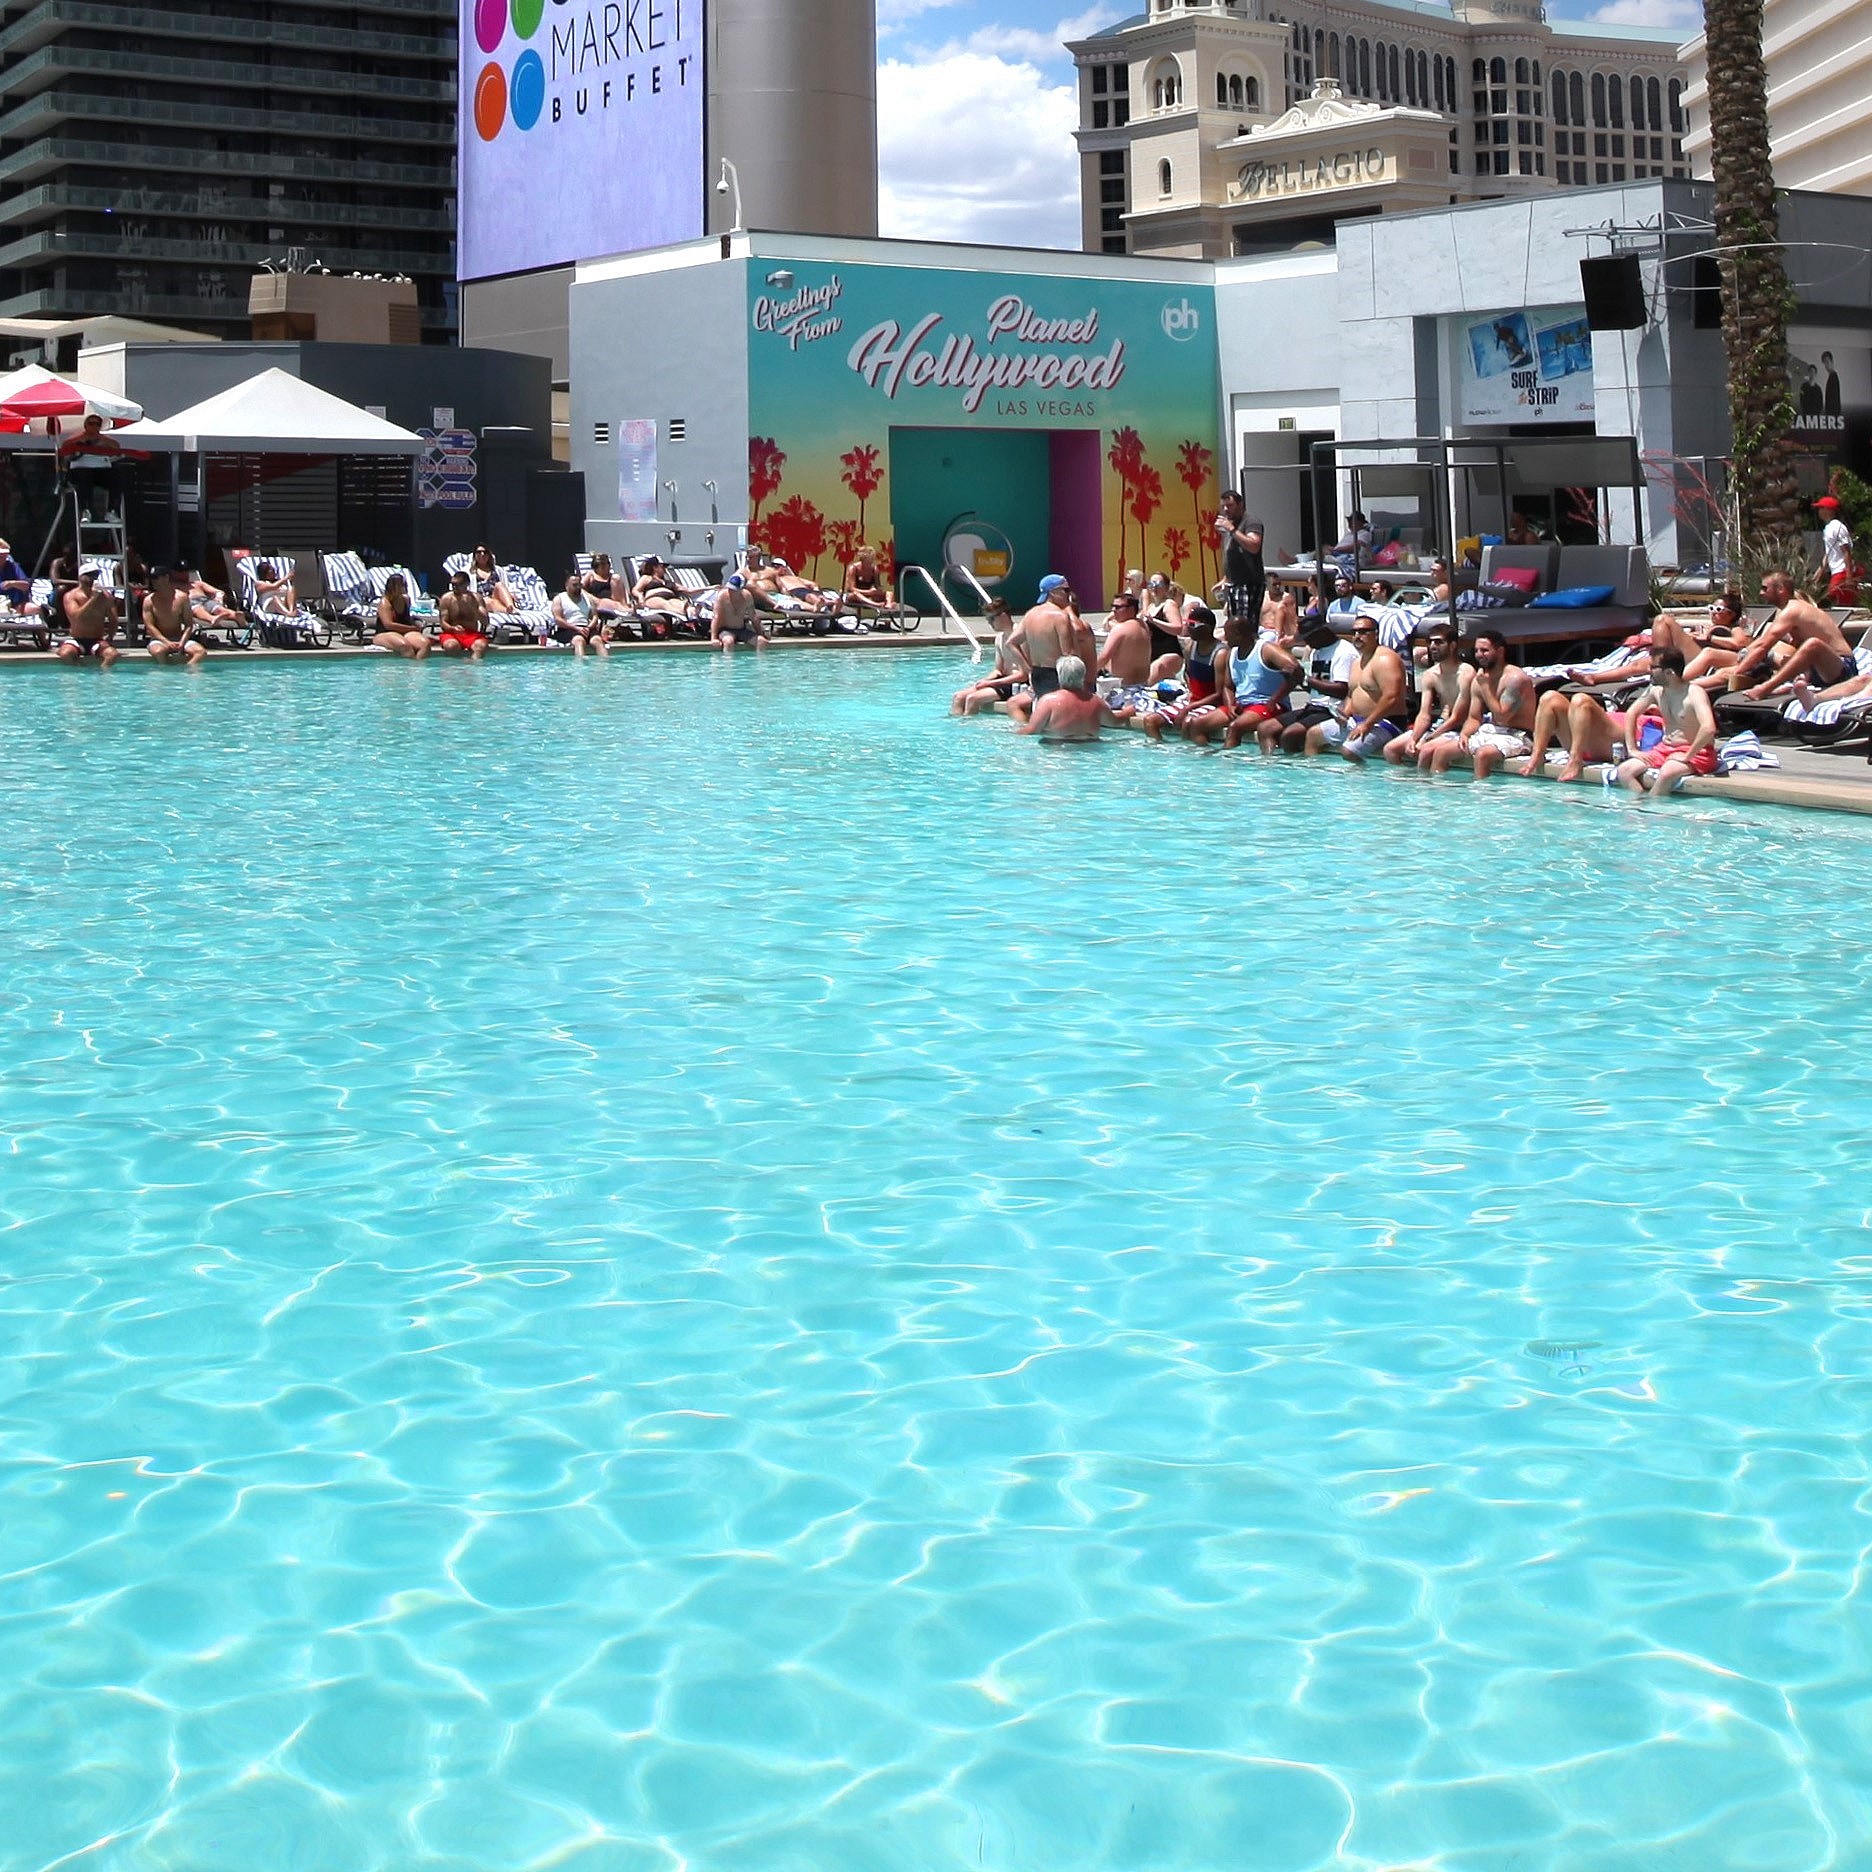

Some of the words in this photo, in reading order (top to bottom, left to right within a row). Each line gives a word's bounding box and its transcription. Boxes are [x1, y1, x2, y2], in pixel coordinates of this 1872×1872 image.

[551, 57, 689, 124] BUFFET
[1230, 146, 1385, 200] BELLAGIO
[753, 273, 842, 332] Greetings
[986, 294, 1098, 345] Planet
[777, 310, 841, 351] From
[846, 312, 1127, 414] Hollywood
[1511, 370, 1538, 389] SURF
[997, 399, 1029, 417] LAS
[1036, 400, 1096, 417] VEGAS
[1790, 414, 1845, 430] AMERS
